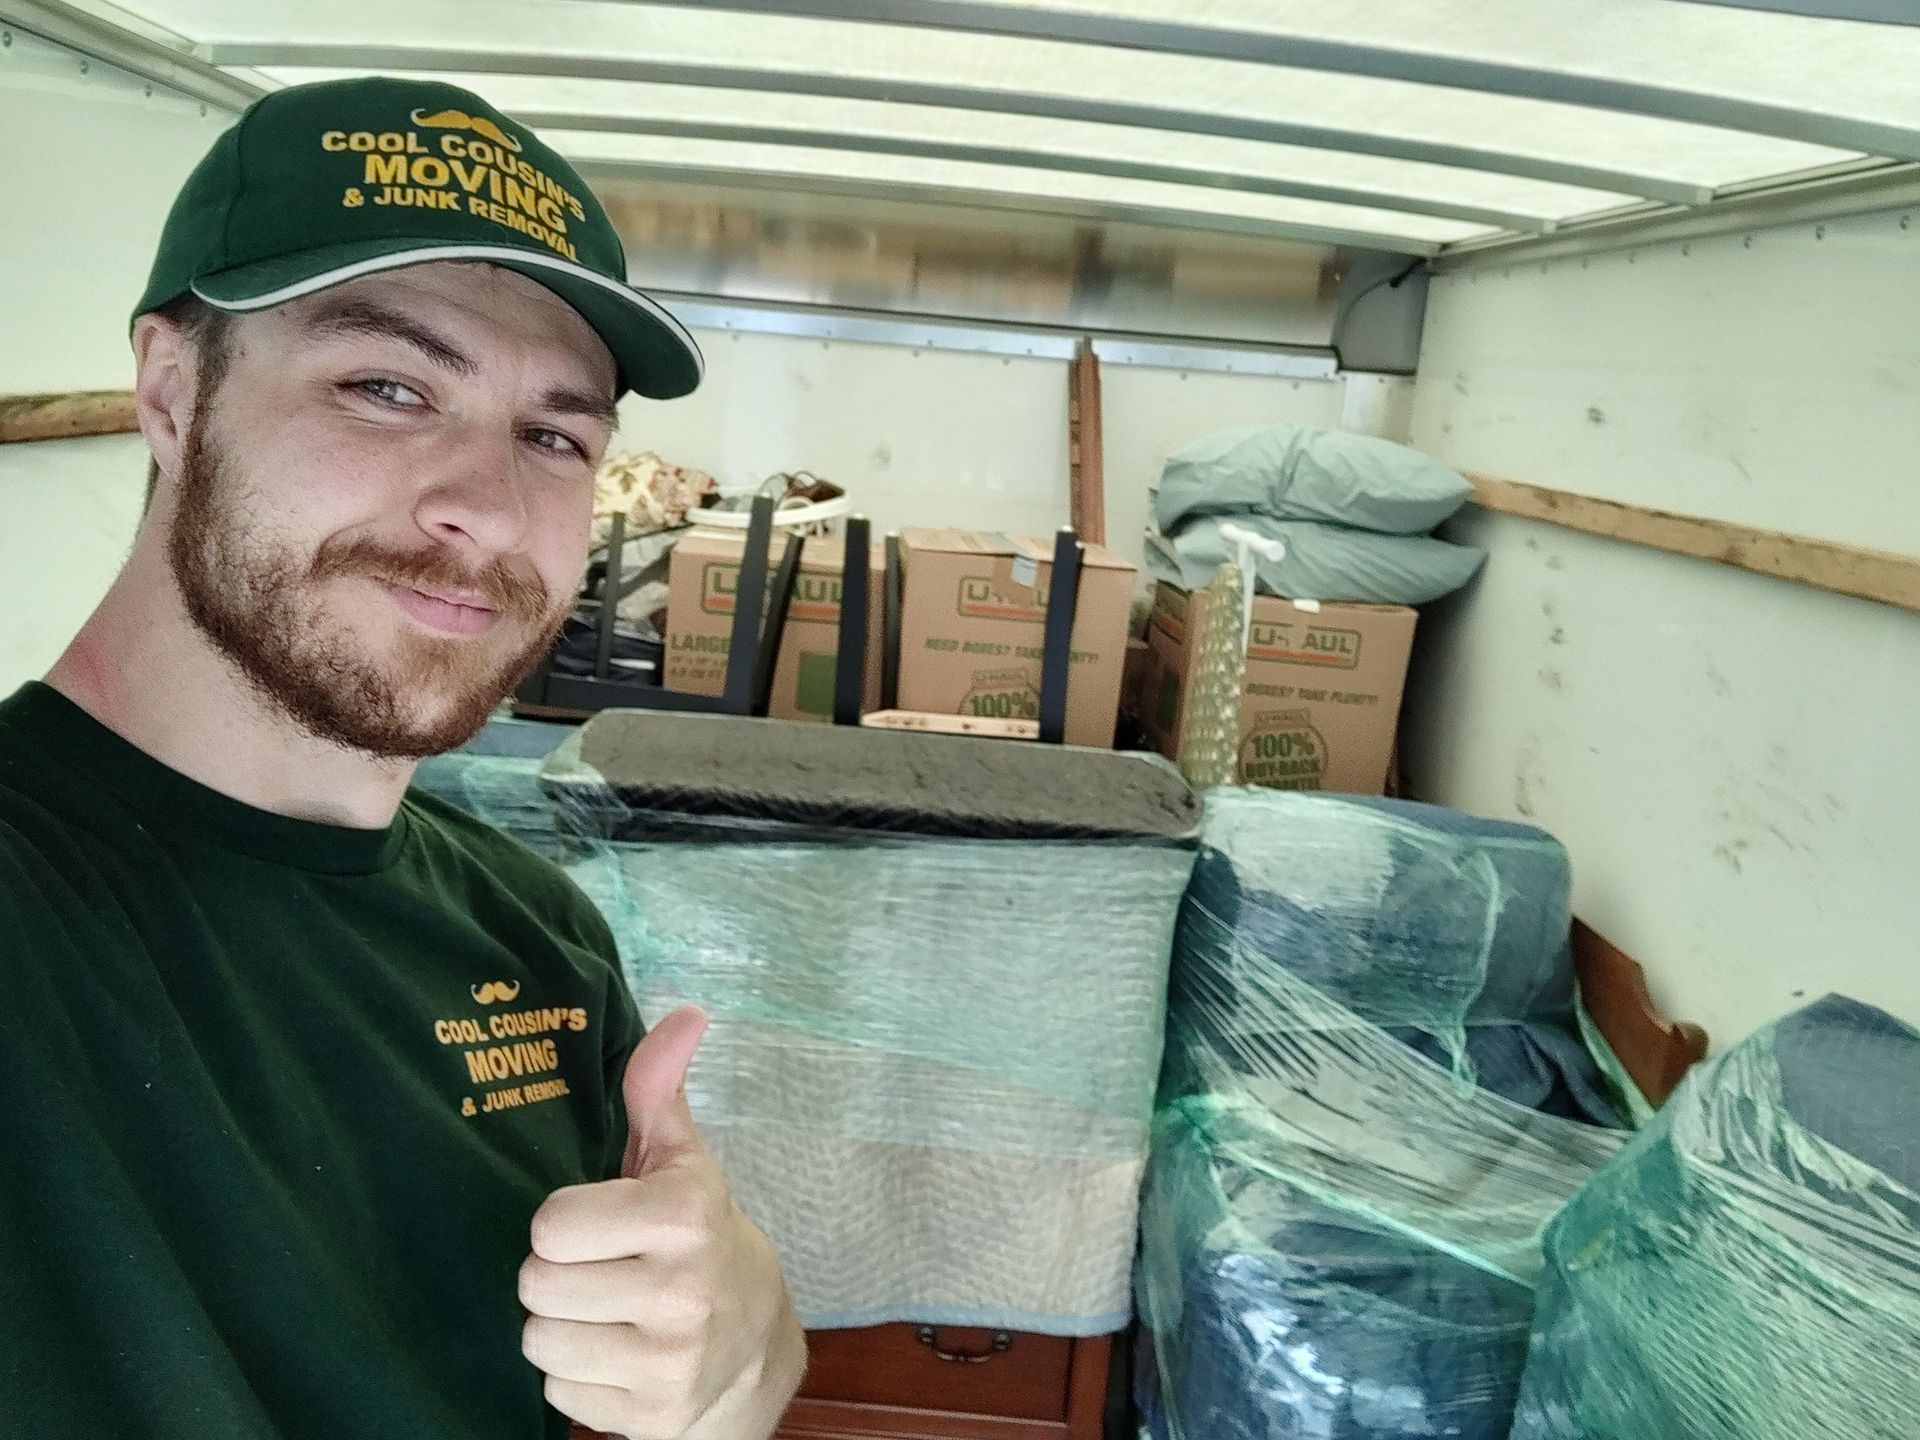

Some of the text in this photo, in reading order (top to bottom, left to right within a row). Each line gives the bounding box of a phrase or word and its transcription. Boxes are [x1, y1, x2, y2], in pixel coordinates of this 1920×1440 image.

[321, 131, 586, 222] COOL COUSIN'S
[364, 154, 567, 233] MOVING
[342, 186, 578, 261] & JUNK REMOVAL
[1252, 732, 1315, 758] 100%
[434, 1008, 588, 1044] COOL COUSIN'S
[464, 1038, 558, 1084] MOVING
[461, 1096, 478, 1117] &
[482, 1087, 525, 1113] JUNK
